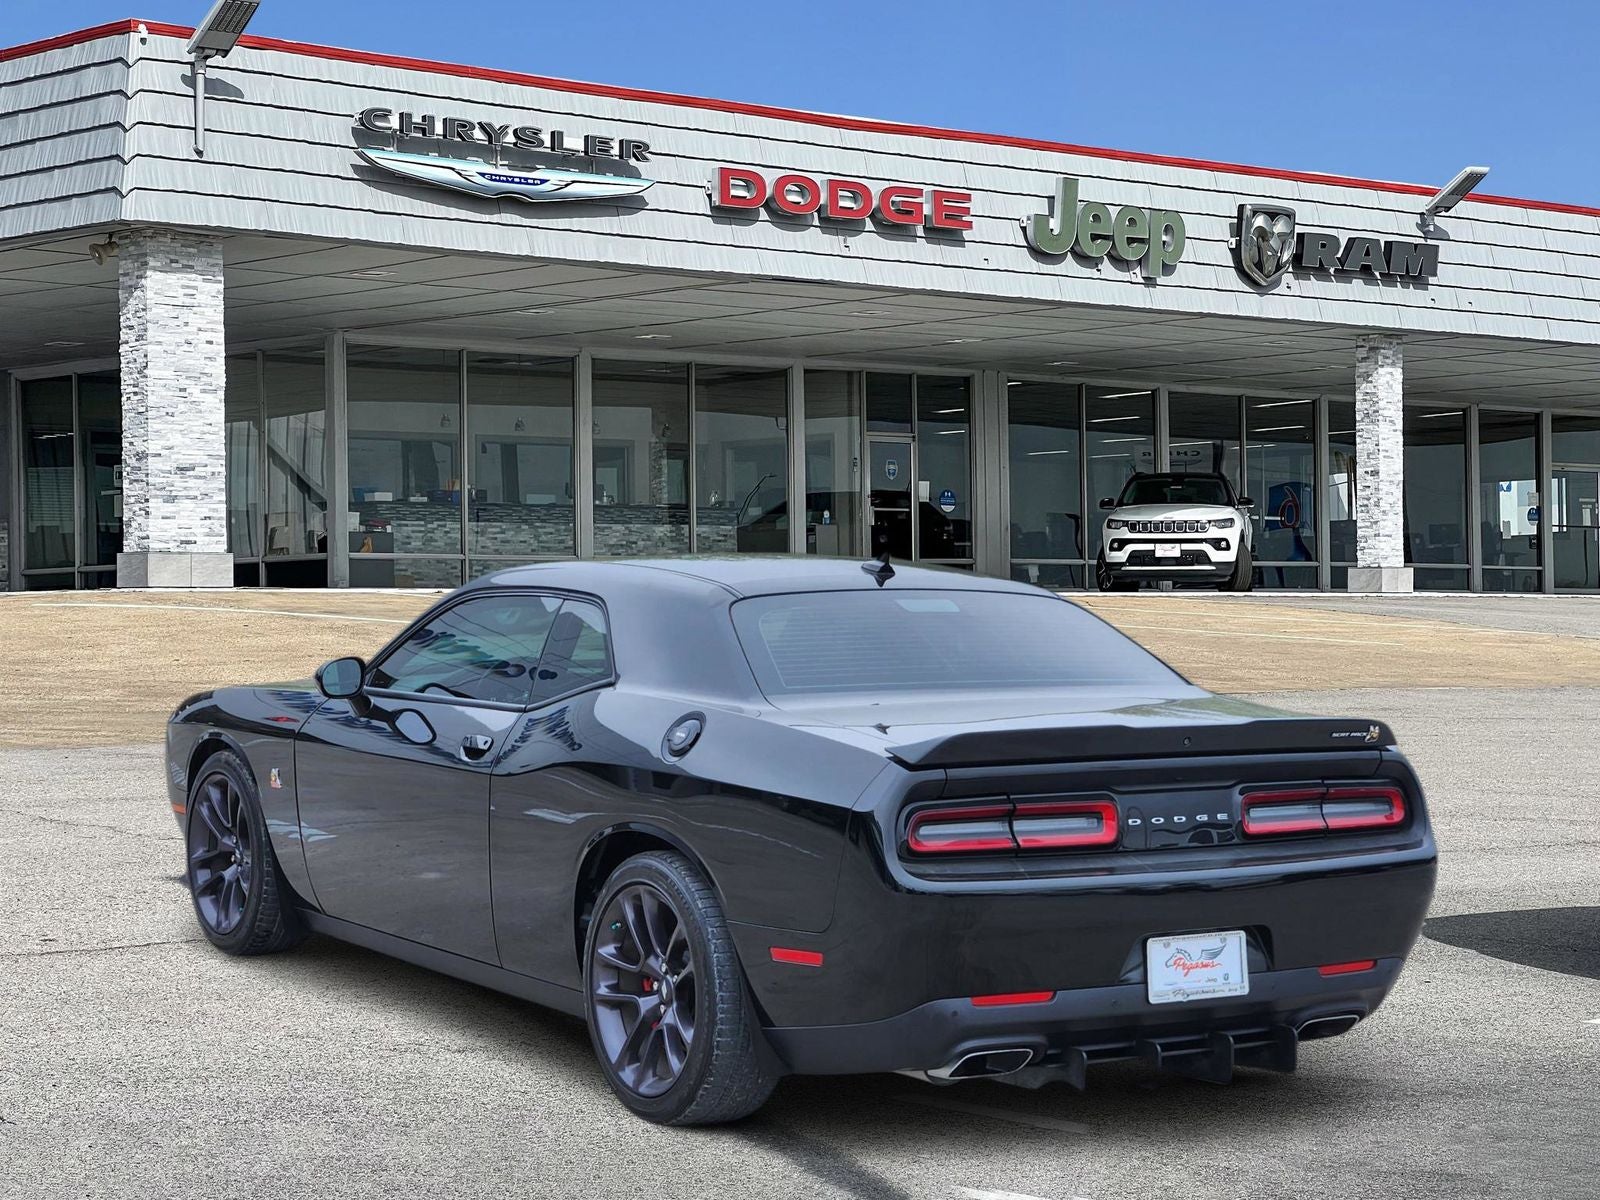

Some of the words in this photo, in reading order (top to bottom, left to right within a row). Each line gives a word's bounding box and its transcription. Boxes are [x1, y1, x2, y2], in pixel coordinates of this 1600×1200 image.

[359, 106, 650, 162] CHRYSLER
[484, 174, 541, 185] CHRYSLER
[712, 167, 973, 230] DODGE
[1025, 177, 1186, 278] Jeep
[1294, 232, 1440, 277] RAM
[1127, 813, 1229, 826] DODGE
